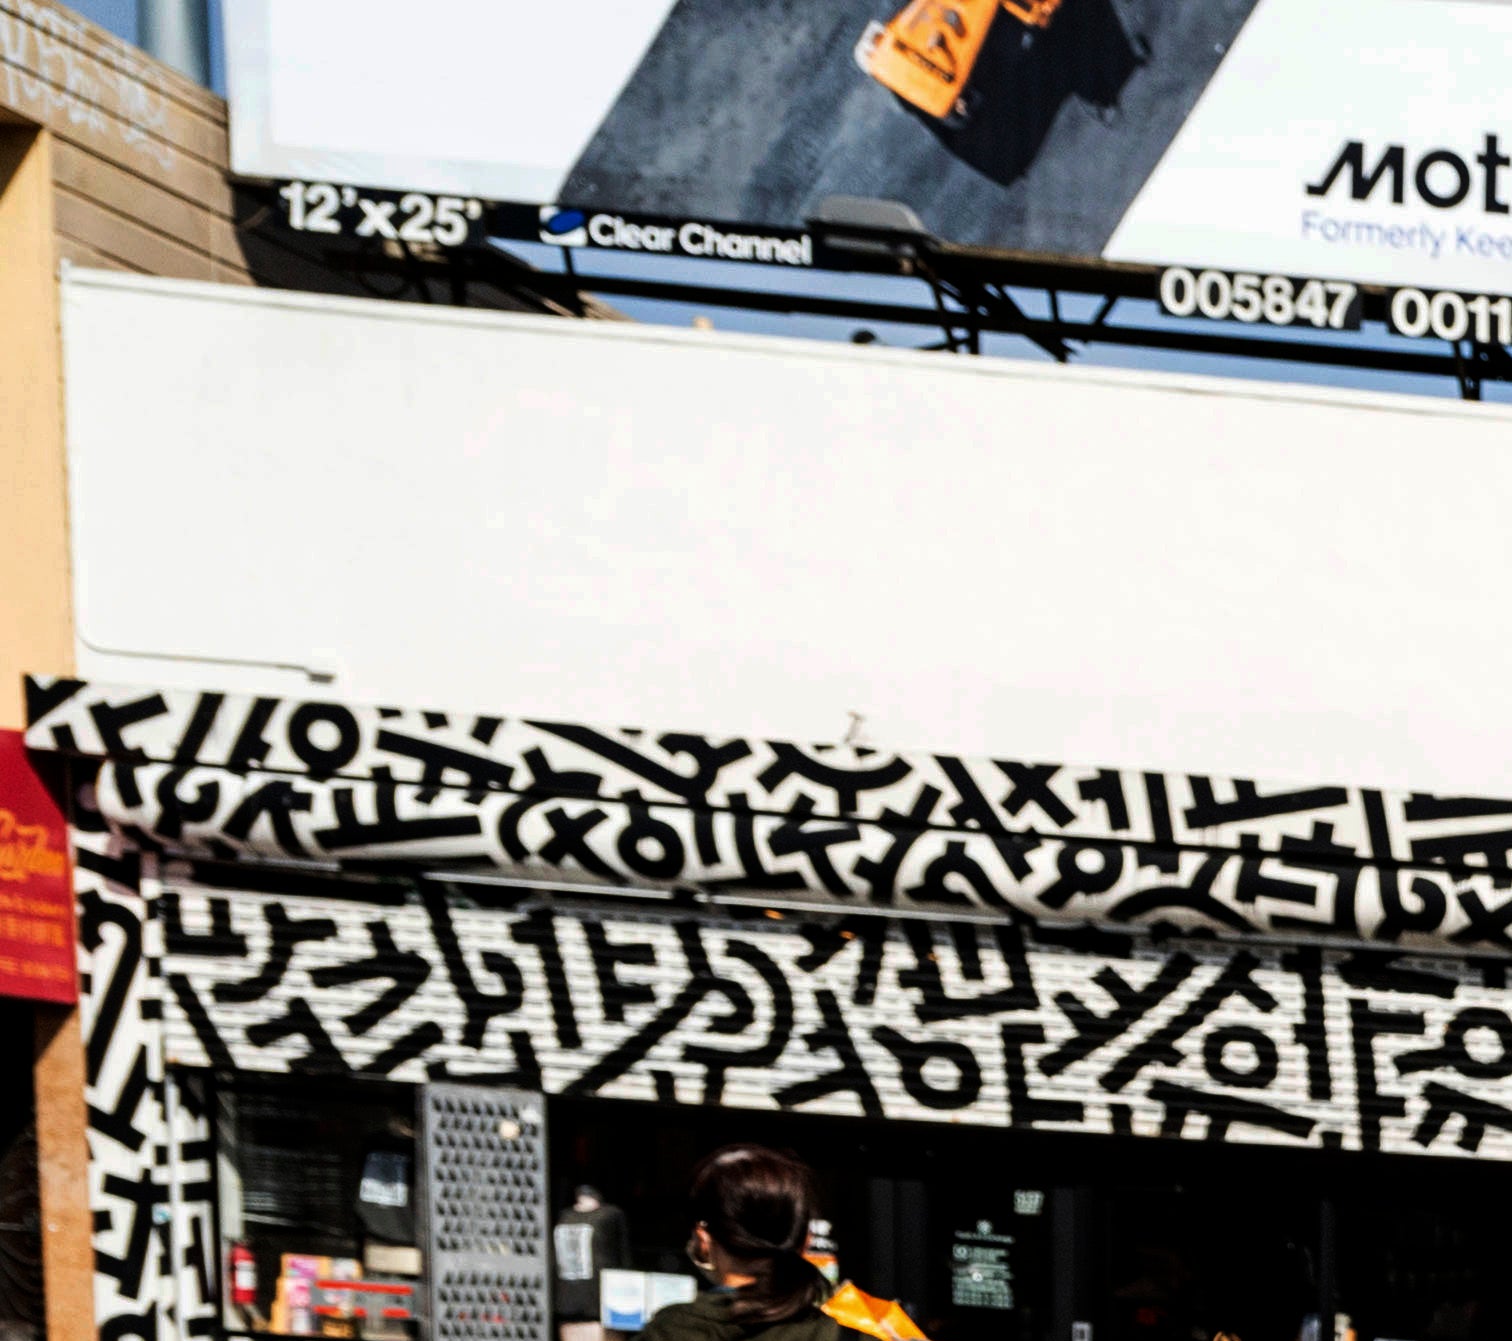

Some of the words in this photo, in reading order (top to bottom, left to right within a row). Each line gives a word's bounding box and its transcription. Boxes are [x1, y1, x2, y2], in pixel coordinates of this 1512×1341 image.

[588, 214, 675, 251] Clear
[678, 223, 812, 265] Channel
[1300, 210, 1447, 258] Formerly
[1159, 266, 1357, 330] 005847
